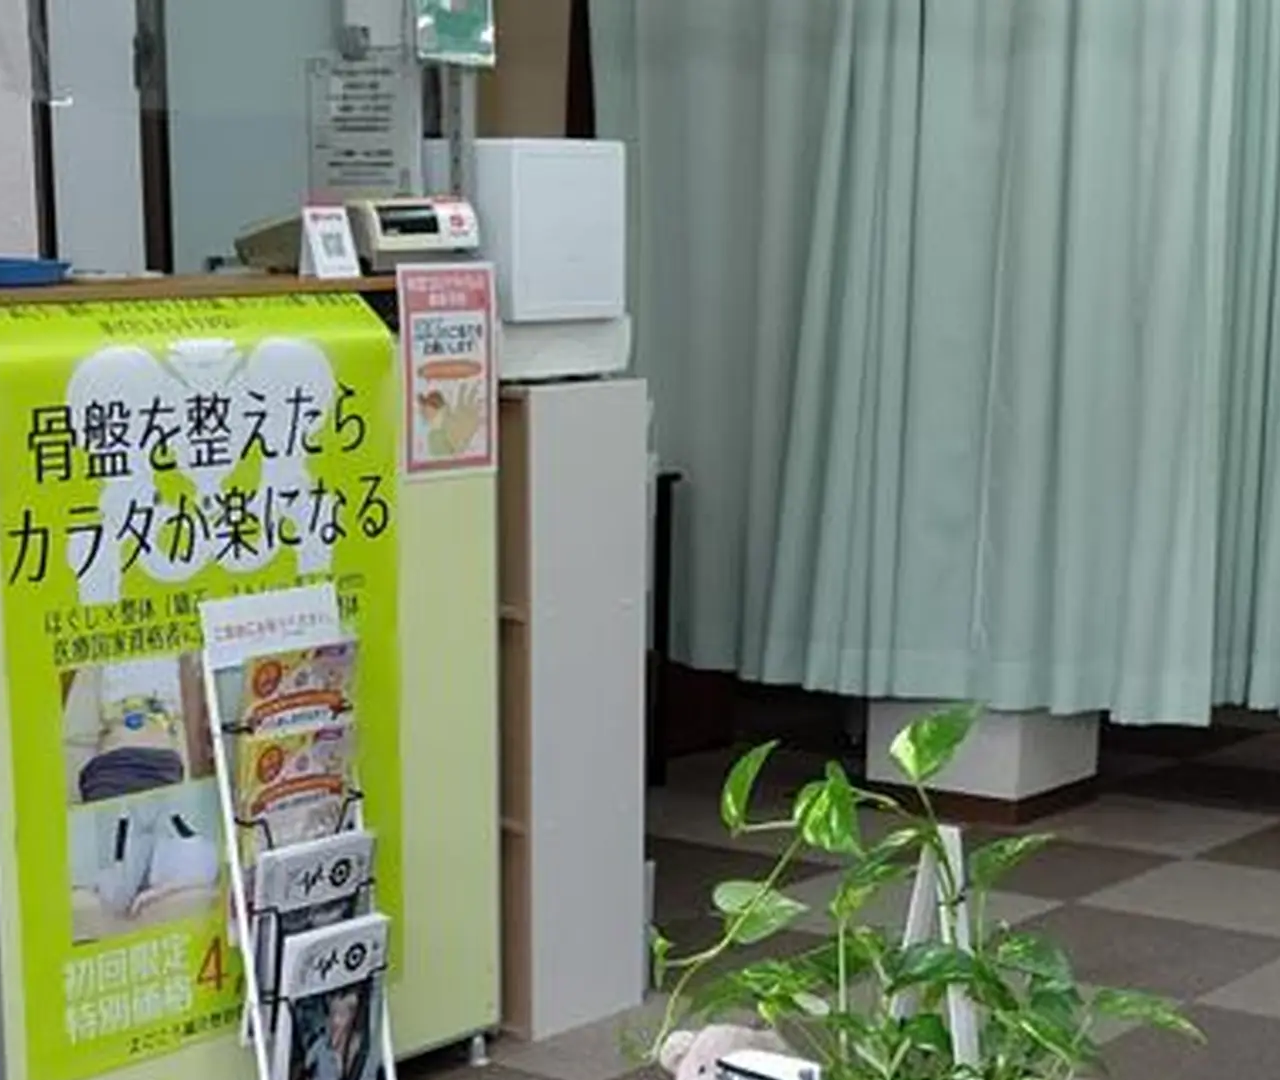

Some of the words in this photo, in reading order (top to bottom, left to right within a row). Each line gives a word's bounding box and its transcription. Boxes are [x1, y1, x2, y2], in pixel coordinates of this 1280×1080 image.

[27, 381, 366, 485] 骨盤を整えたら
[7, 474, 391, 586] カラダが楽になる
